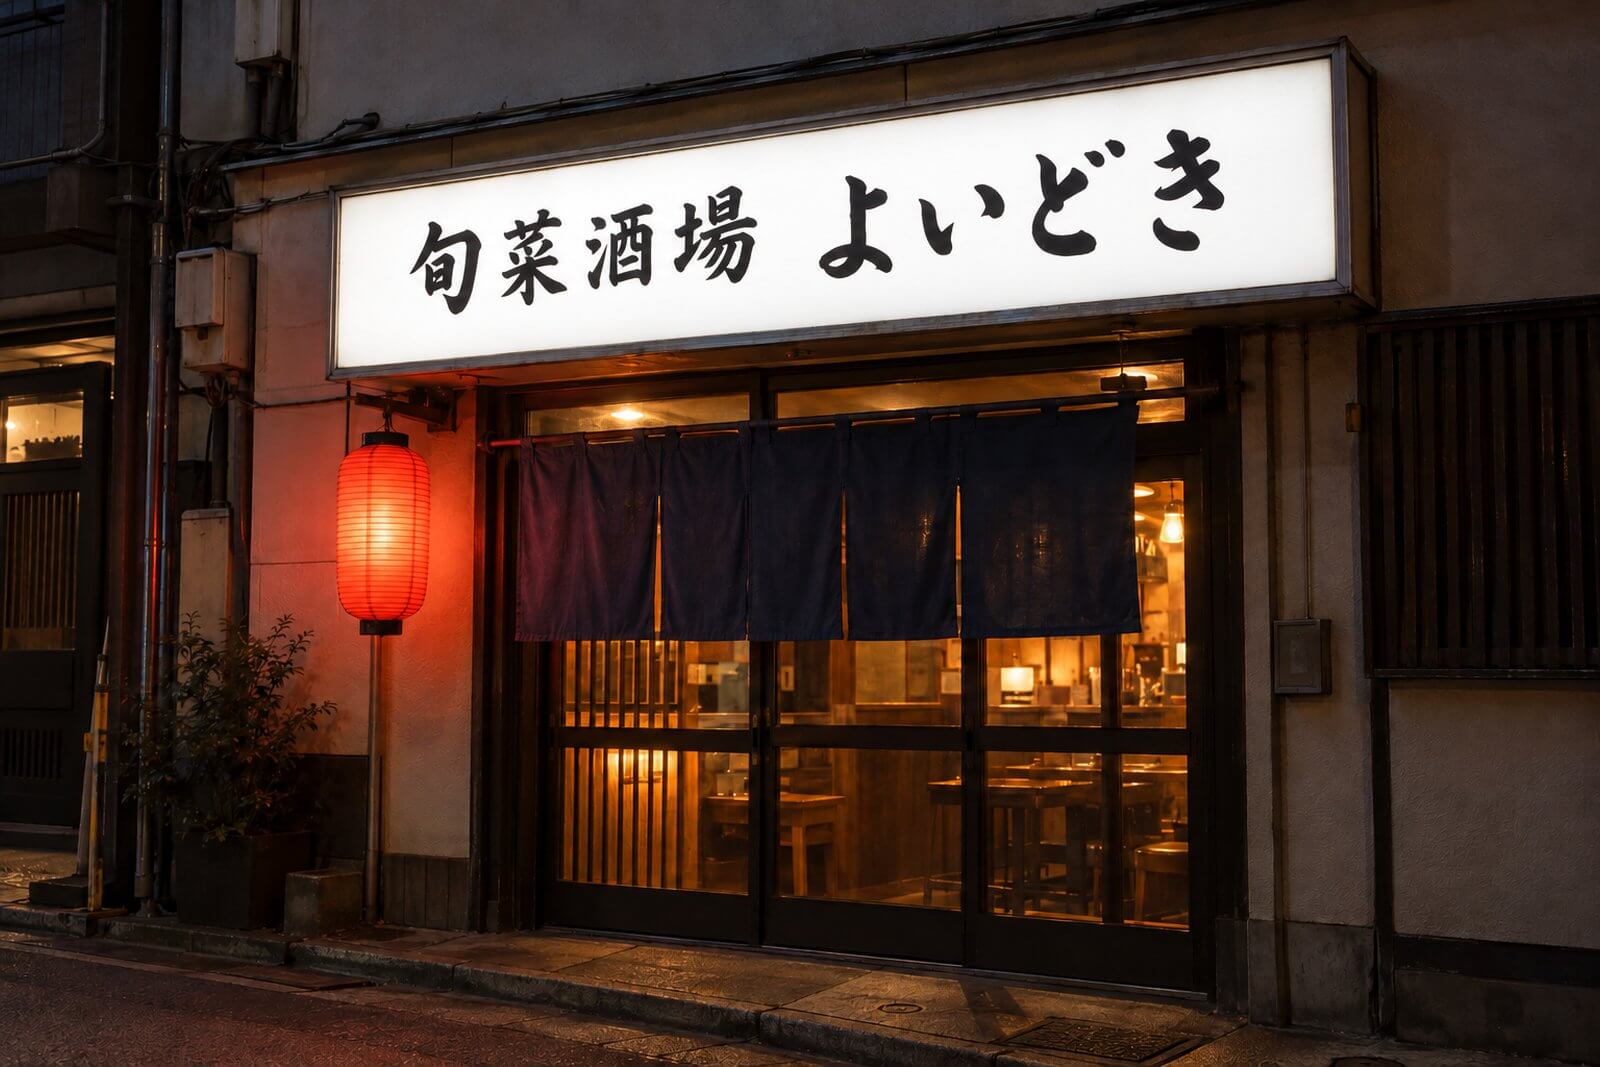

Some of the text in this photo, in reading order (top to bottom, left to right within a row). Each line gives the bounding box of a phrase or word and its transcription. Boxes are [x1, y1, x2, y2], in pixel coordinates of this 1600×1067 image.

[410, 128, 1225, 315] 旬菜酒場 よいどき
